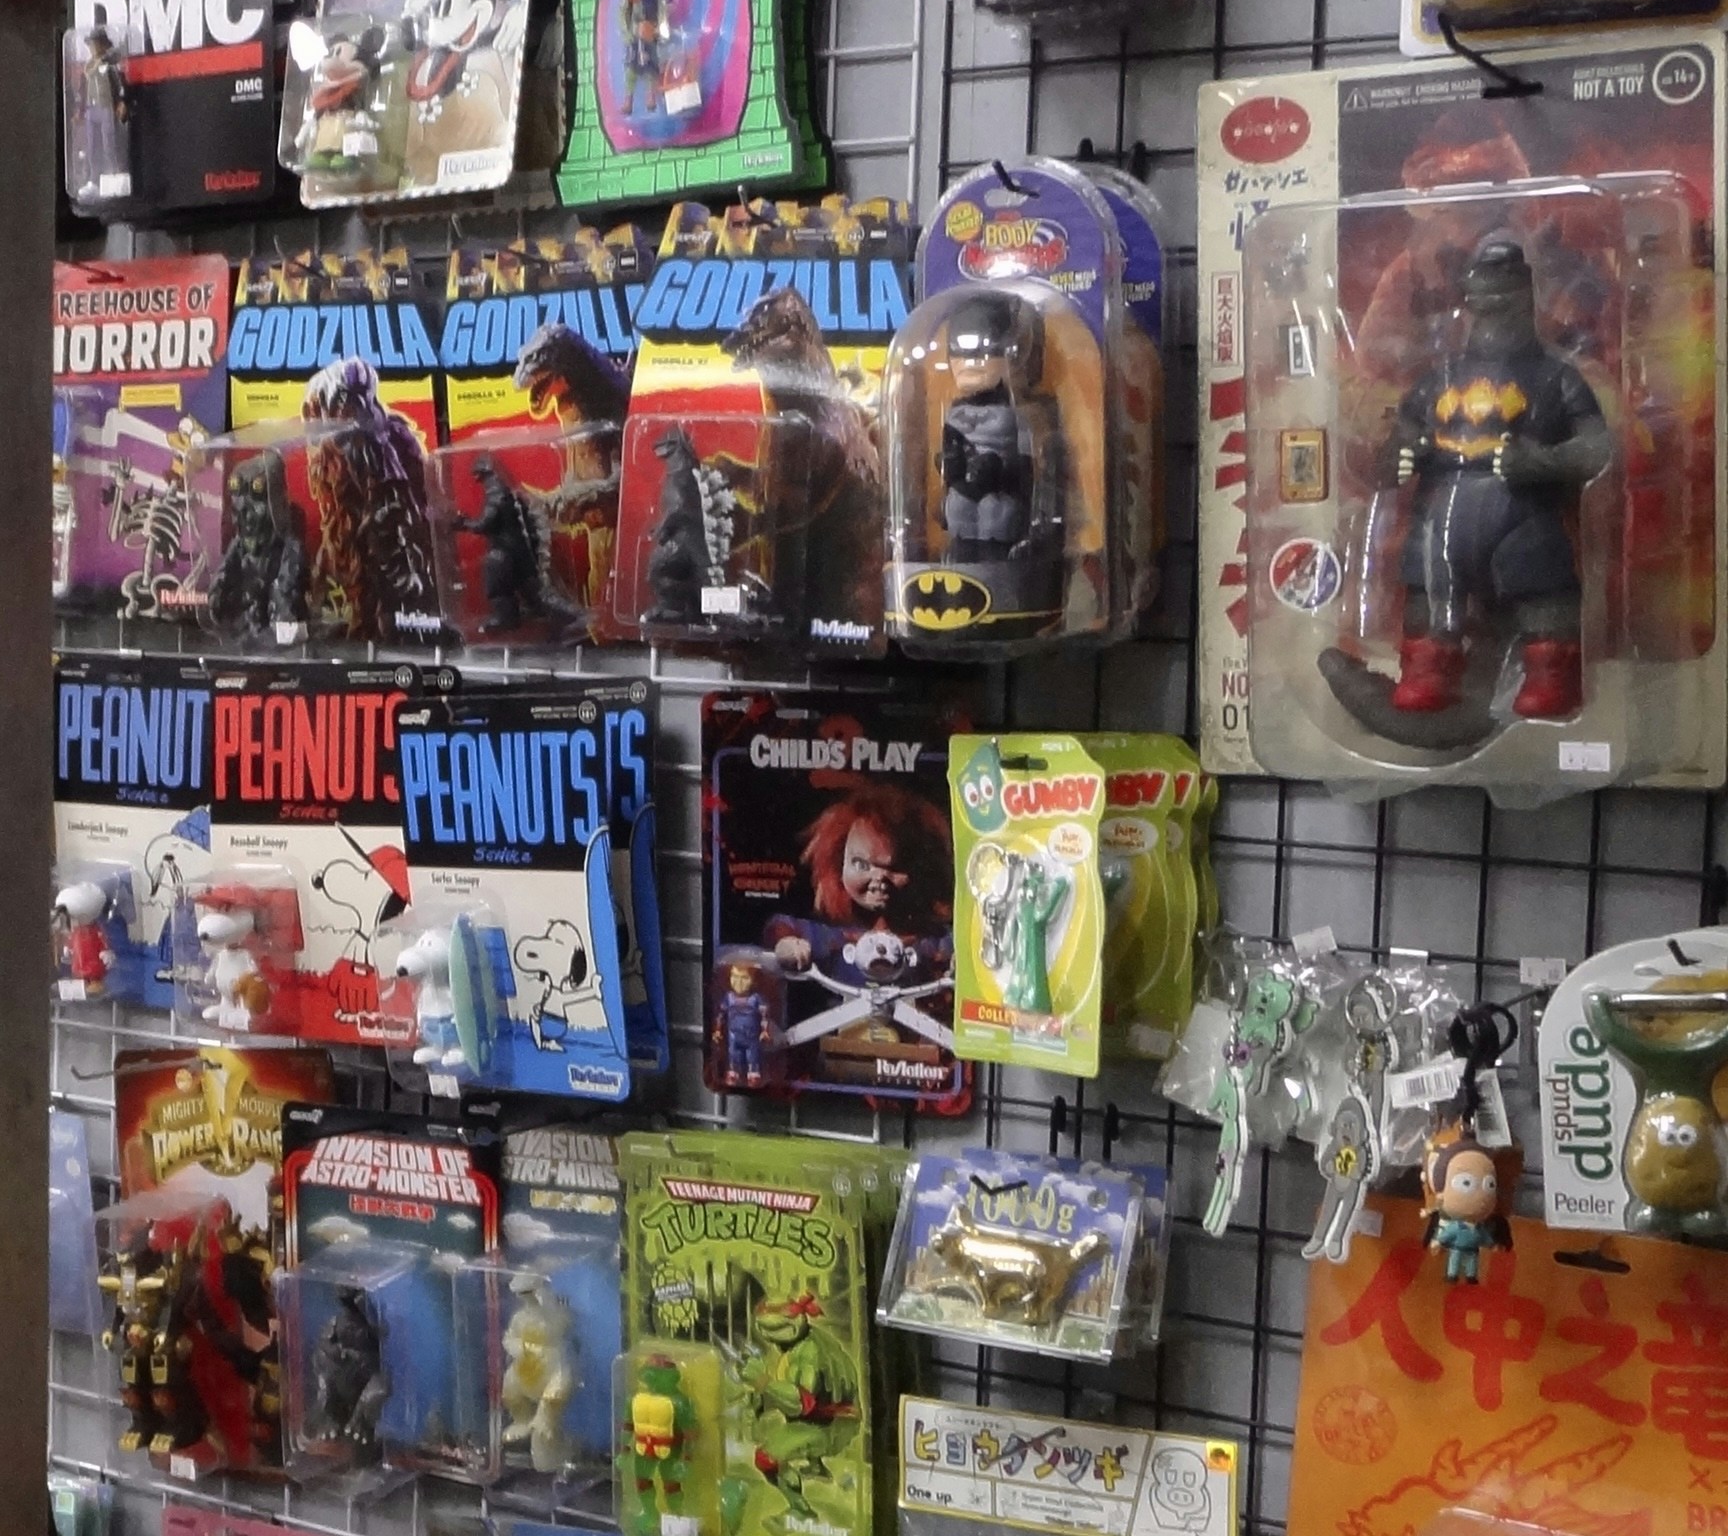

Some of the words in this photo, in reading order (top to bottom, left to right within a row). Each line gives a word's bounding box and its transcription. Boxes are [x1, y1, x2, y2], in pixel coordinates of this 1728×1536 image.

[1573, 78, 1602, 101] NOT
[1604, 77, 1615, 97] A
[1617, 74, 1644, 95] TOY
[983, 219, 1040, 248] BODY
[54, 286, 178, 319] REEHOUSE
[185, 282, 215, 311] OF
[636, 259, 911, 332] GODZILLA
[227, 302, 440, 370] GODZILLA
[58, 682, 210, 790] PEANUT
[749, 733, 847, 770] CHILD'S
[851, 736, 923, 773] PLAY
[399, 729, 602, 847] PEANUTS
[1001, 773, 1102, 820] GUMBY
[105, 823, 129, 837] Snoopy
[229, 834, 261, 847] Baseball
[262, 836, 289, 850] Snoopy
[454, 873, 480, 887] Snoopy
[162, 1097, 205, 1123] MIGHTY
[1545, 1075, 1578, 1142] spud
[1554, 1026, 1615, 1181] dude
[152, 1122, 215, 1179] POWER
[313, 1134, 436, 1173] INVASION
[437, 1145, 472, 1177] OF
[300, 1162, 482, 1206] ASTRO-MONSTER
[665, 1179, 725, 1202] TEENAGE
[725, 1185, 773, 1207] MUTANT
[773, 1193, 813, 1212] NINJA
[1554, 1192, 1616, 1214] Peeler
[640, 1200, 837, 1269] TURTLES
[907, 1484, 933, 1500] One
